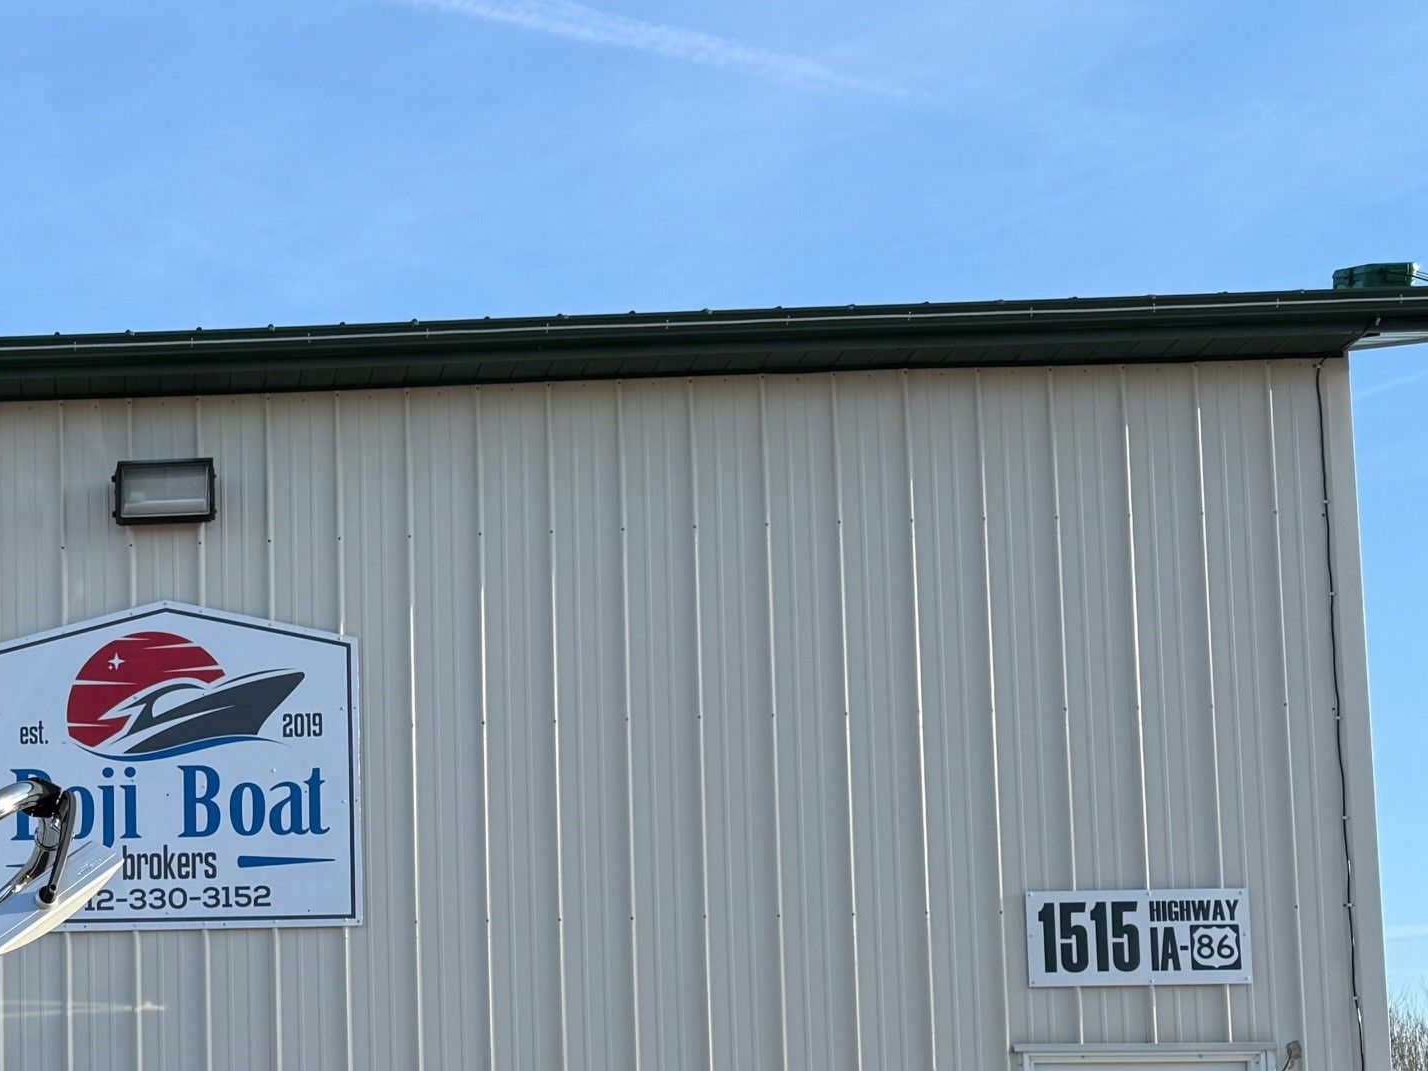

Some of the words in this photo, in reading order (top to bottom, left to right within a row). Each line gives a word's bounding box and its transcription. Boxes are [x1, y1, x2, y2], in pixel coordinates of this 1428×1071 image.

[20, 720, 49, 744] est.
[282, 713, 323, 738] 2019
[177, 765, 330, 838] Boat
[123, 845, 217, 880] brokers
[84, 886, 272, 911] 12-330-3152
[1149, 899, 1239, 922] HIGHWAY
[1038, 901, 1141, 973] 1515
